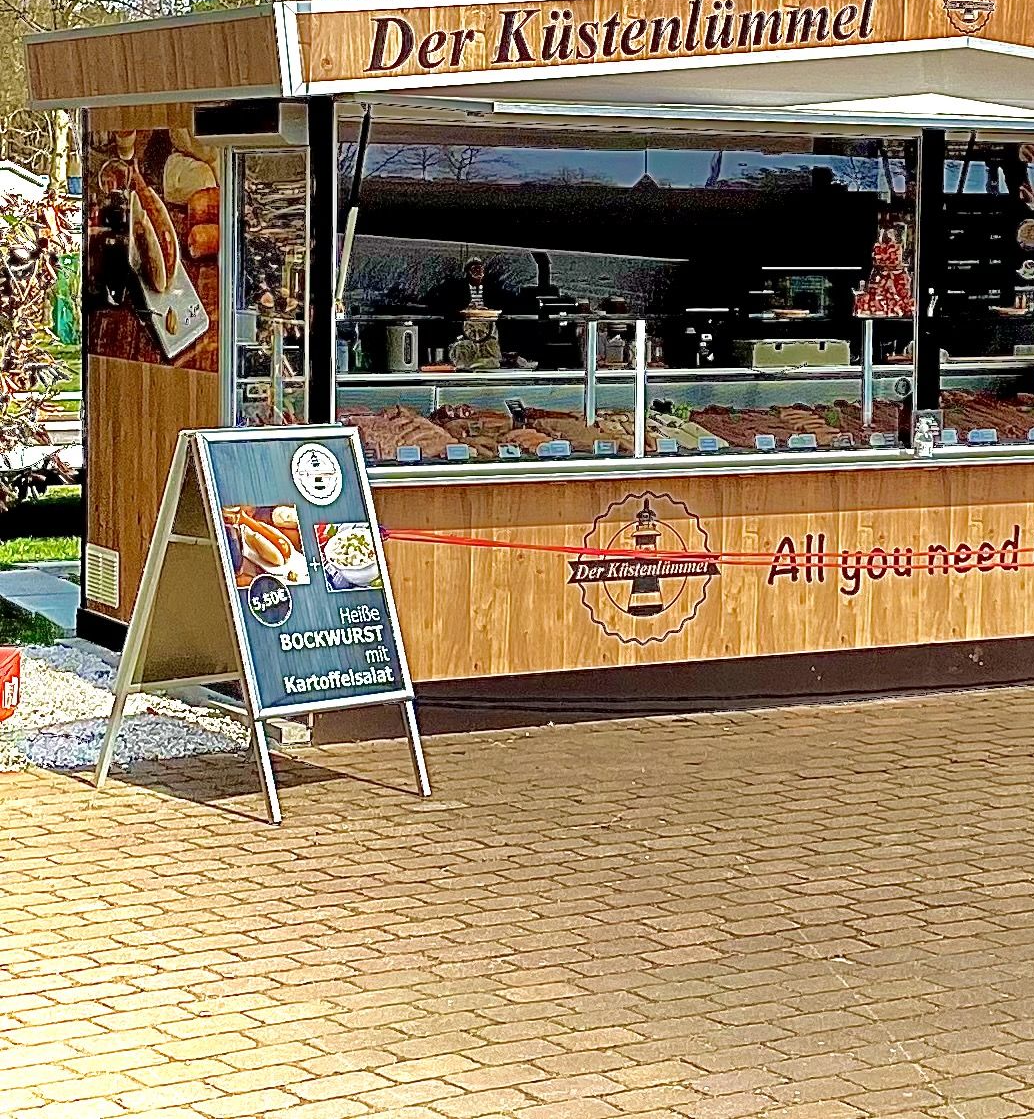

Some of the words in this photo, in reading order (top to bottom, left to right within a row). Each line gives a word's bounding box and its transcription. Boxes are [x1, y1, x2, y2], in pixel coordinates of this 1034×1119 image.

[363, 16, 475, 74] Der
[575, 564, 605, 580] Der
[606, 560, 709, 578] Küstenlümmel
[767, 535, 826, 585] All
[839, 544, 913, 596] you
[927, 524, 1021, 576] need
[251, 587, 288, 612] 5,50€
[339, 604, 381, 625] Heiße
[279, 624, 384, 651] BOCKWURST
[364, 645, 391, 664] mit
[283, 665, 395, 694] Kartoffelsalat
